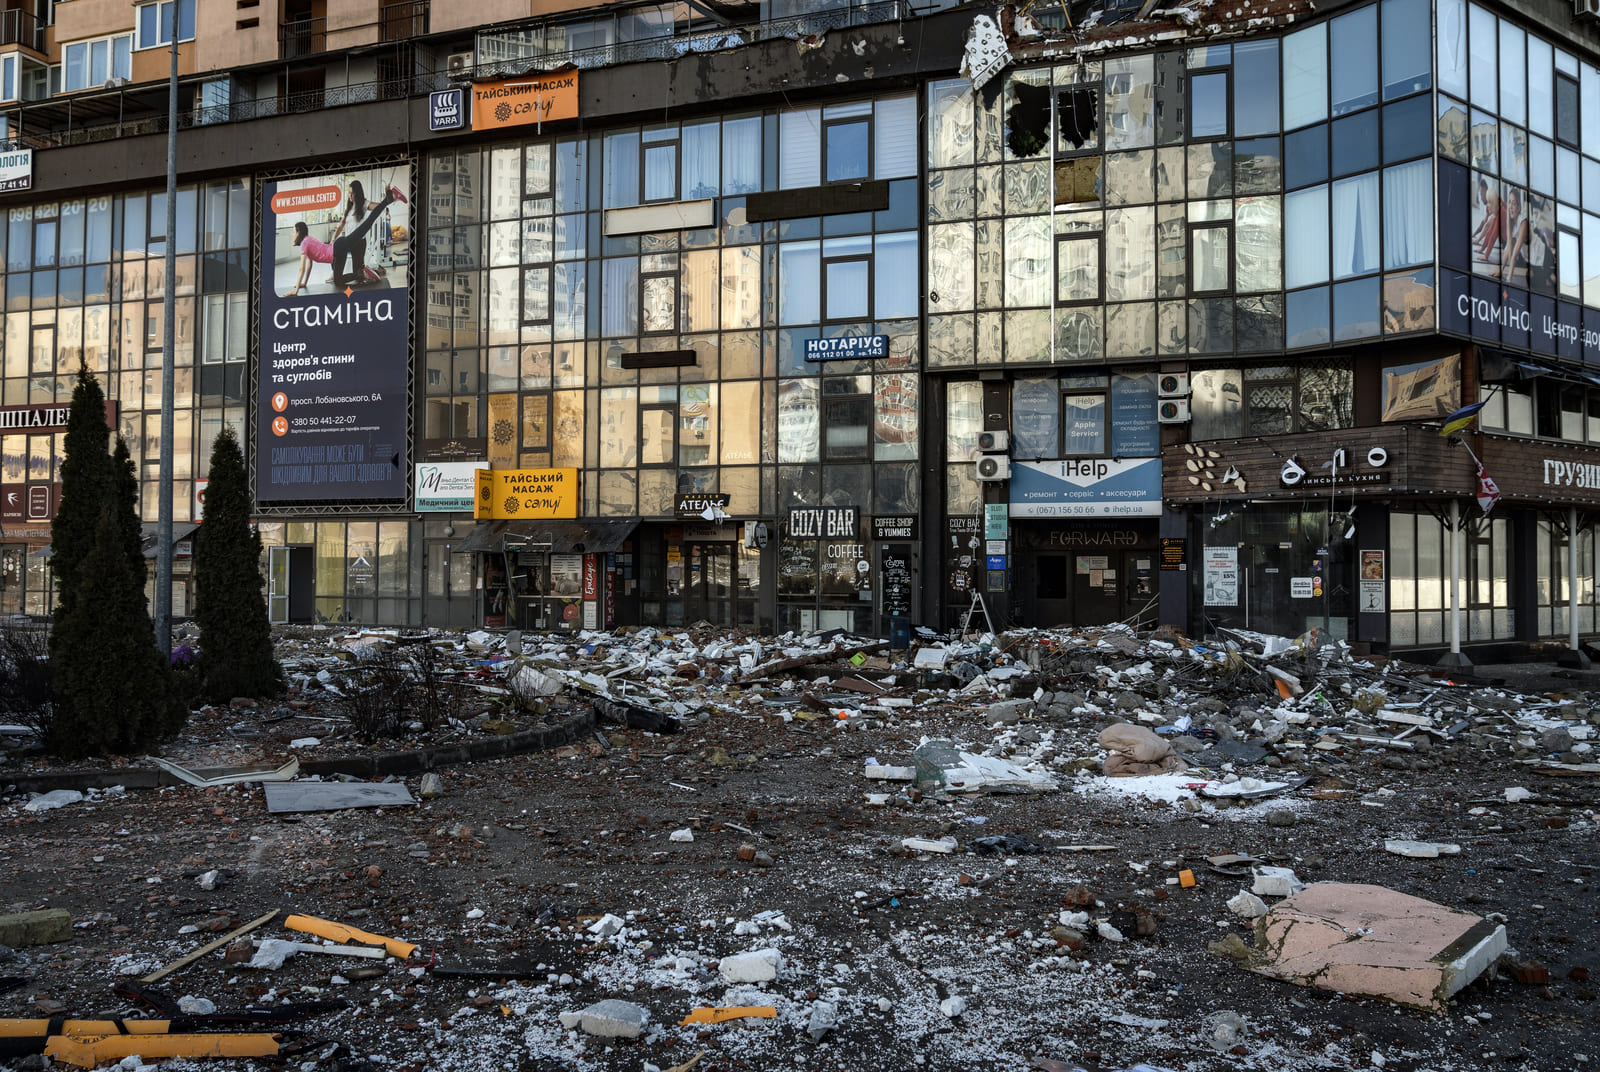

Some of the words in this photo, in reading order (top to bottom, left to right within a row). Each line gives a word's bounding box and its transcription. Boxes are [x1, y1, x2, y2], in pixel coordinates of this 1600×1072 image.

[476, 82, 532, 100] ТАЙСЬКИЙ
[534, 78, 575, 91] МАСАЖ
[434, 116, 458, 126] YARA
[275, 192, 337, 208] WWW.STAMINA.CENTER
[9, 206, 33, 222] 098
[34, 203, 59, 219] 420
[1543, 315, 1577, 344] Центр
[273, 342, 307, 354] Центр
[808, 336, 882, 352] НОТАРІУС
[272, 355, 319, 369] здоров'я
[321, 354, 355, 365] спини
[272, 373, 284, 383] та
[286, 369, 332, 384] суглобів
[1075, 397, 1096, 406] iHelp
[309, 417, 319, 425] 50
[320, 415, 356, 425] 441-22-07
[1074, 421, 1096, 429] Apple
[1071, 430, 1099, 438] Service
[1061, 459, 1108, 479] iHelp
[504, 472, 563, 483] ТАЙСЬКИЙ
[512, 485, 553, 493] МАСАЖ
[1029, 491, 1057, 499] ремонт
[1069, 490, 1095, 499] сервіс
[1106, 489, 1147, 499] аксесуари
[1036, 506, 1056, 514] (067)
[1112, 505, 1143, 514] ihelp.ua
[790, 509, 824, 537] COZY
[827, 509, 854, 537] BAR
[875, 517, 896, 527] COFFEE
[897, 517, 914, 527] SHOP
[949, 518, 966, 528] COZY
[967, 518, 980, 528] BAR
[878, 528, 883, 536] &
[884, 527, 911, 537] YUMMIES
[1050, 530, 1138, 545] FORWARD
[827, 544, 864, 558] COFFEE
